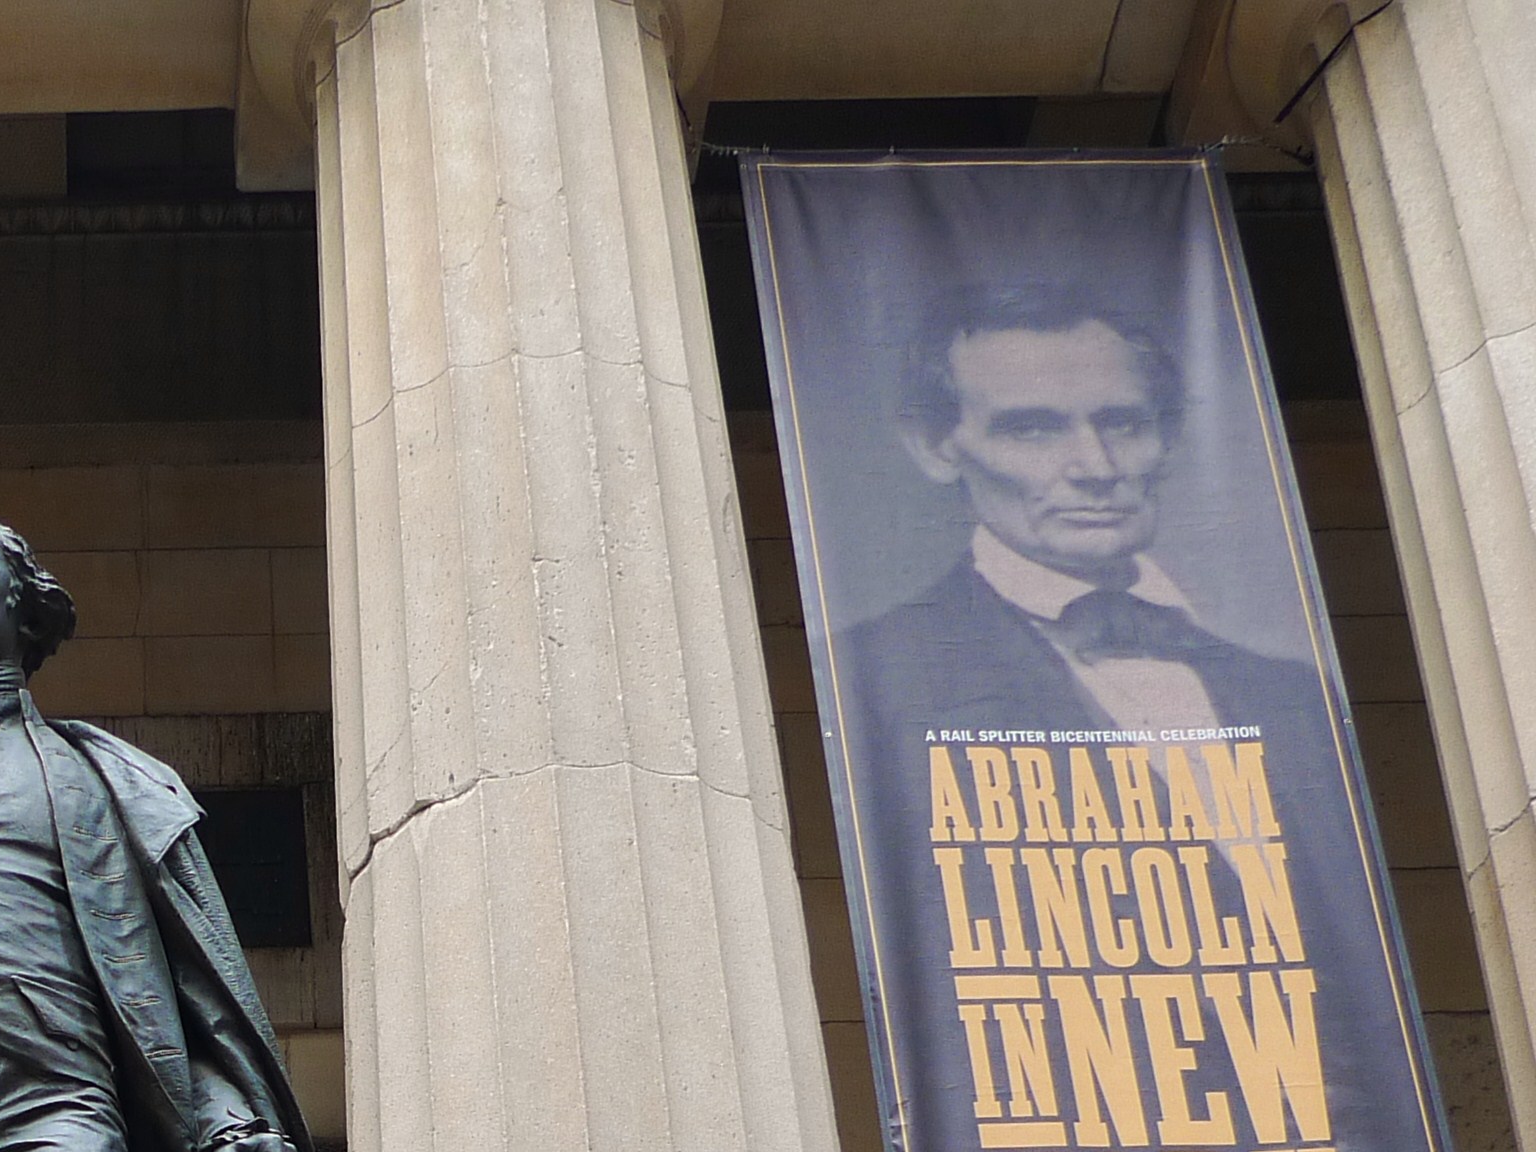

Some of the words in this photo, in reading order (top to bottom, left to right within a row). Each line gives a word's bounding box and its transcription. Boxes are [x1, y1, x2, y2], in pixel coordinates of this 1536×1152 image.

[925, 730, 936, 742] A
[940, 730, 975, 742] RAIL
[978, 730, 1046, 743] SPLITTER
[1050, 730, 1156, 742] BICENTENNIAL
[1160, 726, 1261, 741] CELEBRATION
[929, 742, 1282, 843] ABRAHAM
[934, 842, 1306, 968] LINCOLN
[959, 1002, 1060, 1119] IN
[1049, 969, 1332, 1148] NEW
